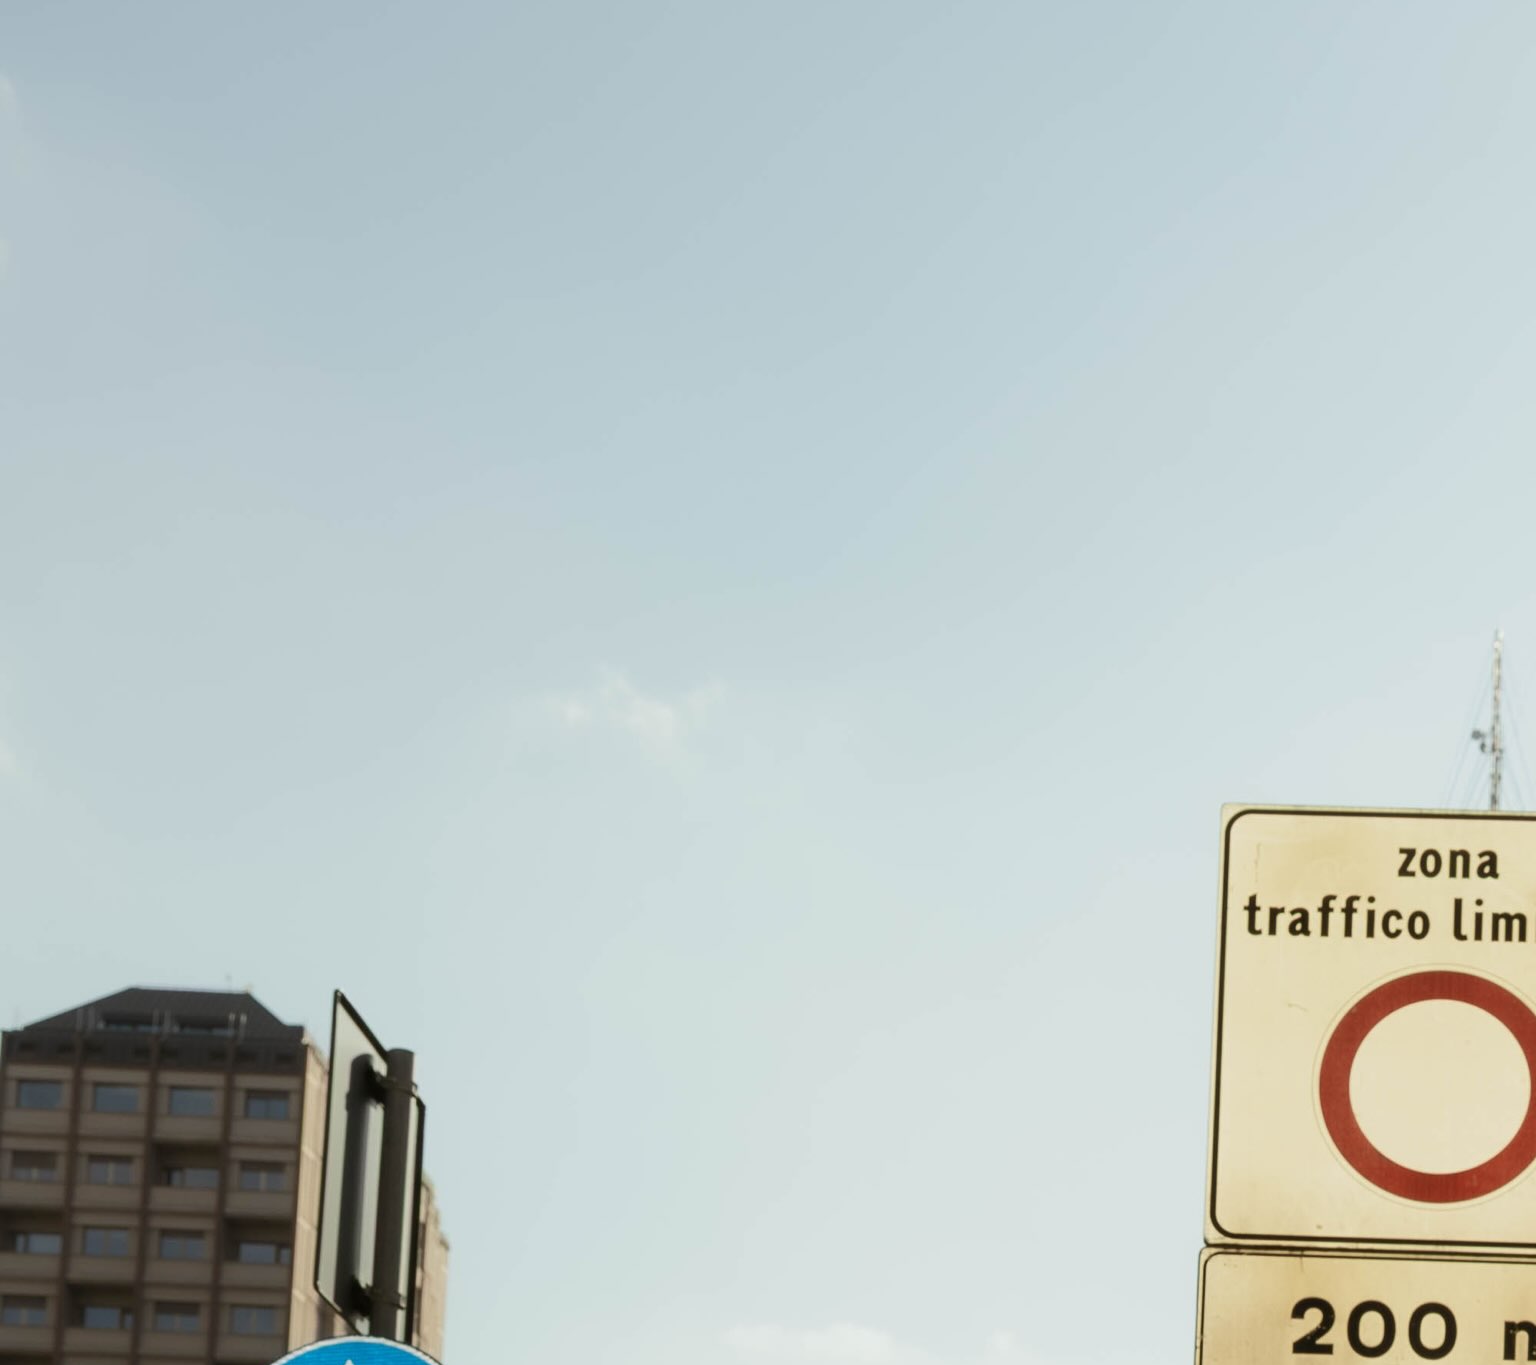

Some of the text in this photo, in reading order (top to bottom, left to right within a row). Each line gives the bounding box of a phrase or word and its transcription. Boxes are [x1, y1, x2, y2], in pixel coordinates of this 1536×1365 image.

[1398, 847, 1500, 880] zona
[1243, 894, 1431, 940] traffico
[1290, 1296, 1458, 1361] 200
